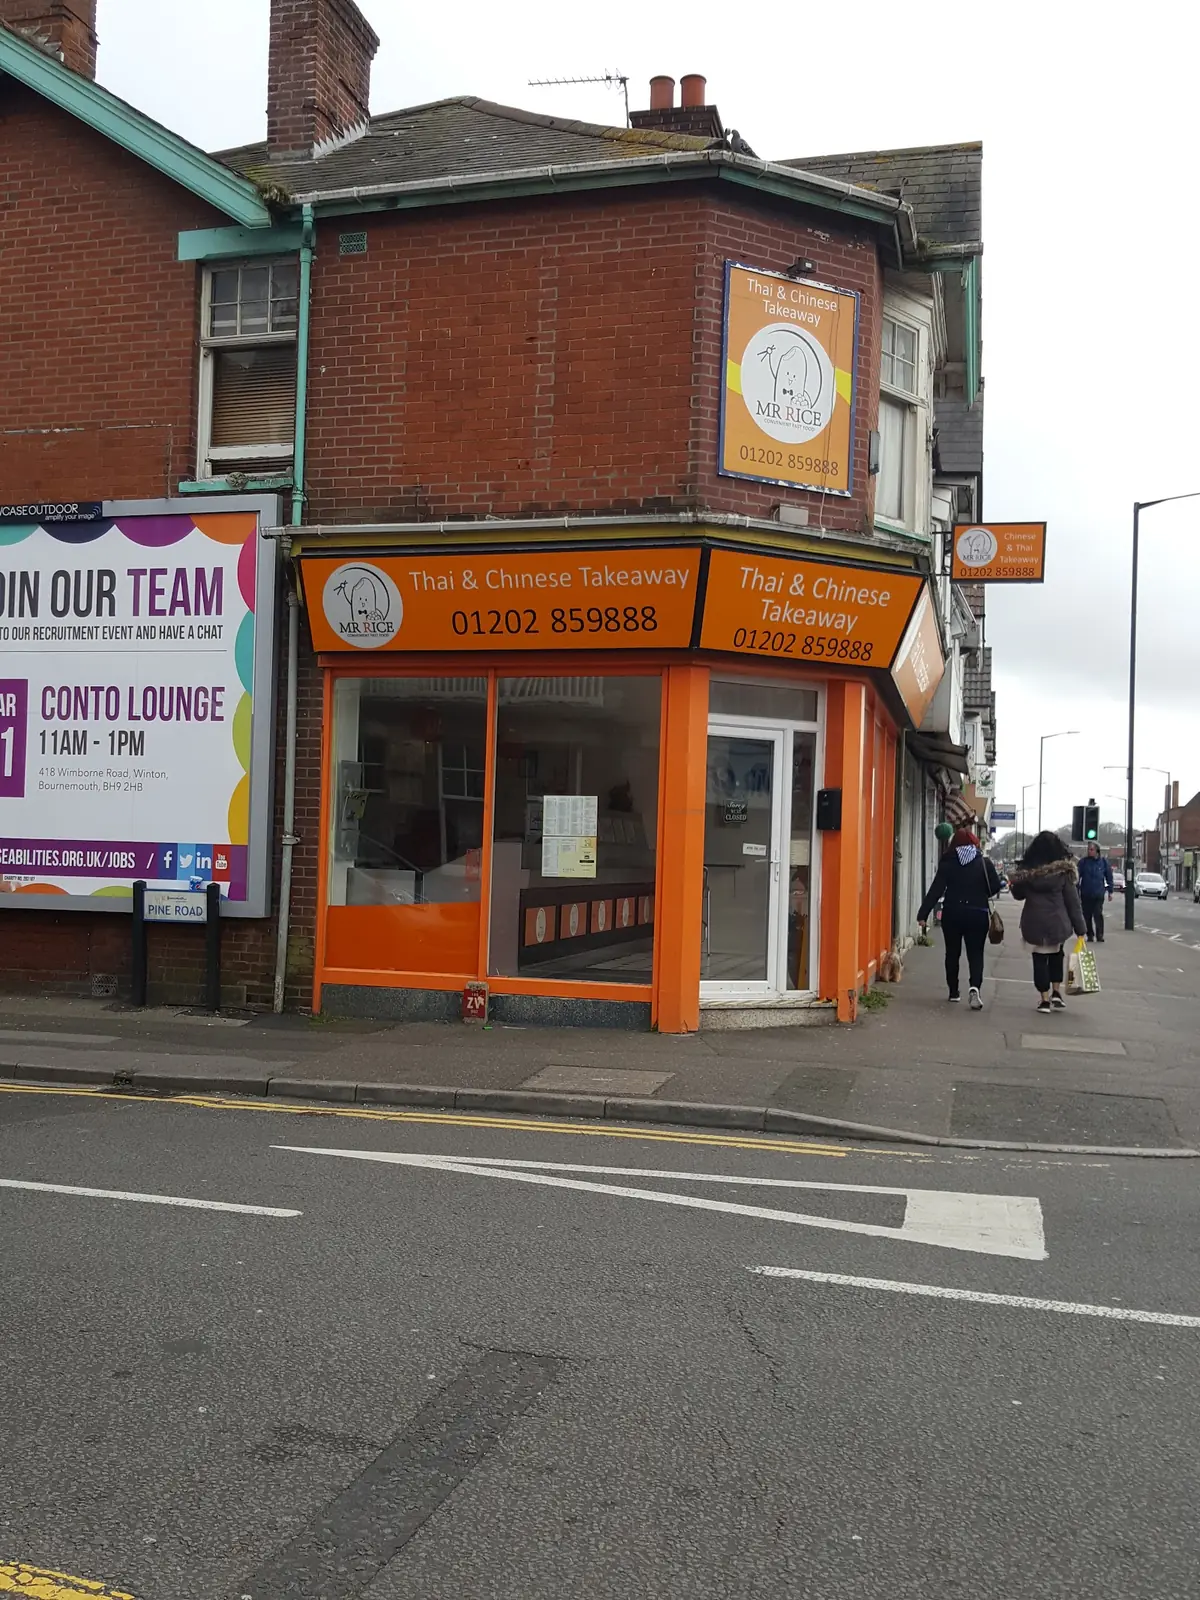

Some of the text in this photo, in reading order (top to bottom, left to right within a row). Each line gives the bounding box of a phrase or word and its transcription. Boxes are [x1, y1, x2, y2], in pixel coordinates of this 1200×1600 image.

[747, 278, 837, 312] Thai & Chinese
[763, 300, 821, 327] Takeaway
[756, 400, 822, 427] MR RICE
[740, 445, 839, 476] 01202 859888
[1004, 532, 1037, 540] Chinese
[1006, 544, 1032, 552] & Thai
[960, 567, 1035, 577] 01202 859888
[1000, 556, 1039, 565] Takeaway
[50, 569, 117, 618] OUR
[126, 566, 224, 617] TEAM
[408, 566, 690, 591] Thai & Chinese Takeaway
[740, 567, 891, 607] Thai & Chinese
[339, 621, 395, 633] MR RICE
[452, 606, 658, 635] 01202 859888
[761, 599, 858, 635] Takeaway
[12, 626, 30, 640] OUR
[32, 626, 100, 640] RECRUITMENT
[102, 625, 134, 640] EVENT
[136, 625, 157, 640] AND
[159, 625, 186, 640] HAVE
[187, 625, 195, 639] A
[197, 624, 223, 640] CHAT
[733, 628, 874, 662] 01202 859888
[41, 685, 226, 722] CONTO LOUNGE
[39, 729, 88, 756] 11AM
[108, 730, 145, 756] 1PM
[38, 767, 169, 780] 418 Wimborne Road, Winton,
[38, 781, 143, 792] Bournemouth, BH9 2HB
[148, 904, 203, 916] PINE ROAD
